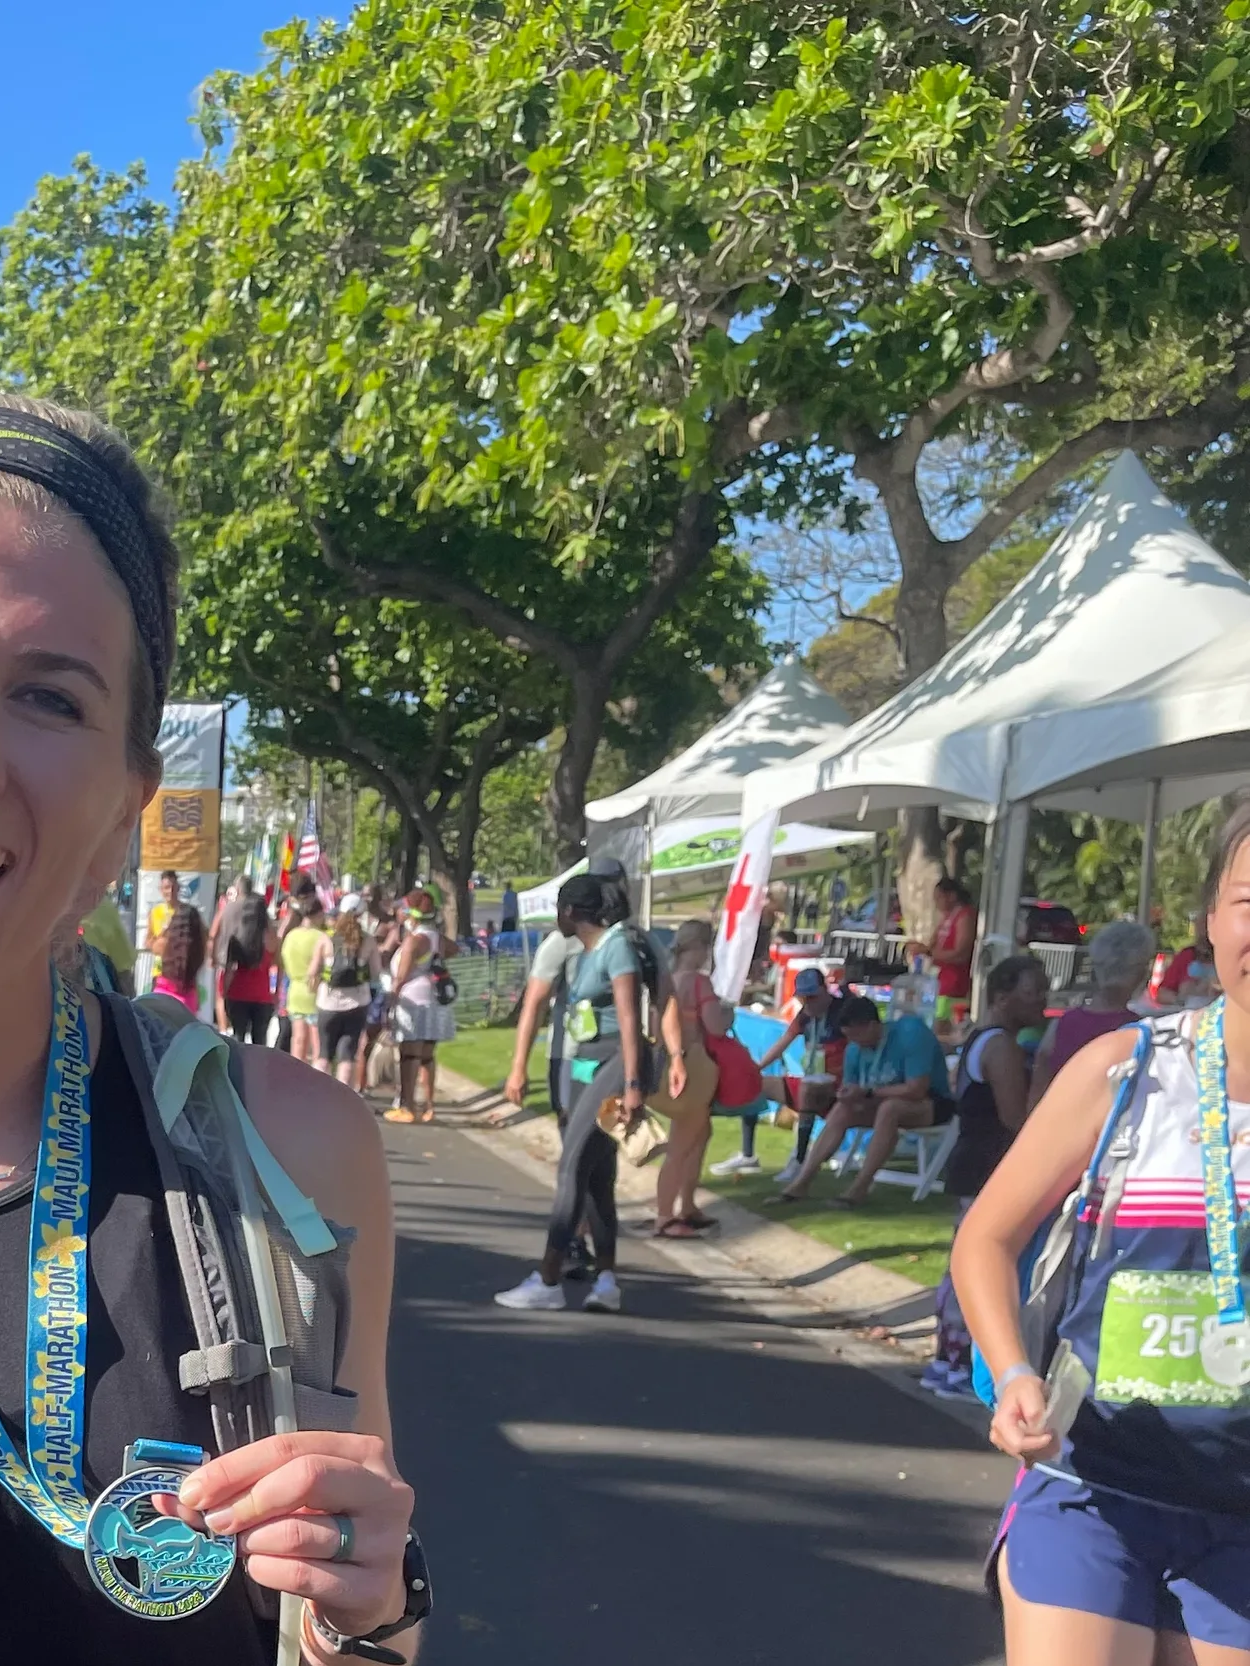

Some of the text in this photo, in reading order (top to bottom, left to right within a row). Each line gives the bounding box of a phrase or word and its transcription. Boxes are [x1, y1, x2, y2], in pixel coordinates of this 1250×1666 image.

[56, 1027, 83, 1152] MARATHON
[51, 1157, 82, 1221] MAUI
[45, 1265, 77, 1465] HALF-MARATHON
[94, 1556, 116, 1588] MAUI
[111, 1583, 176, 1616] MARATHON
